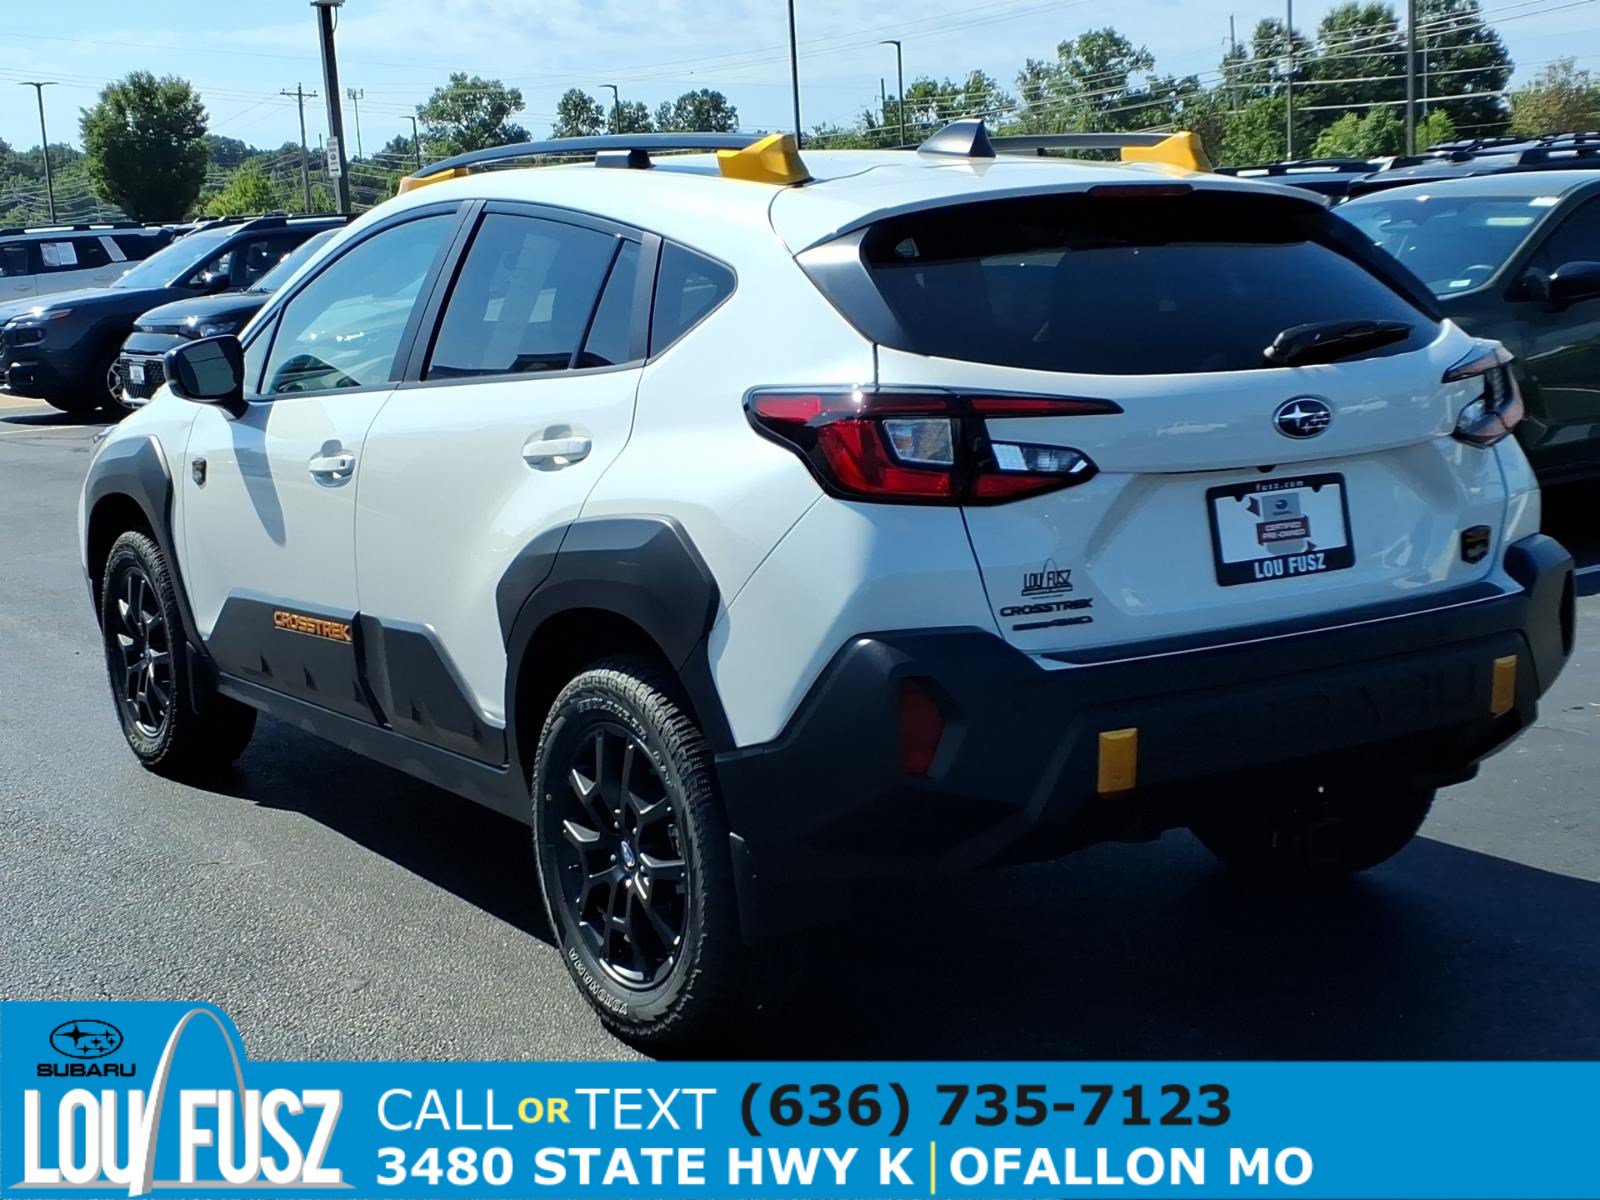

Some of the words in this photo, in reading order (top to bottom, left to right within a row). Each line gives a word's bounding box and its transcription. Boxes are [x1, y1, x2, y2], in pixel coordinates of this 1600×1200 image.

[1256, 480, 1304, 491] fusz.com
[1254, 558, 1284, 579] LOU
[1289, 553, 1327, 575] FUSZ
[1000, 597, 1093, 617] CROSSTREK
[273, 610, 352, 642] CROSSTREK
